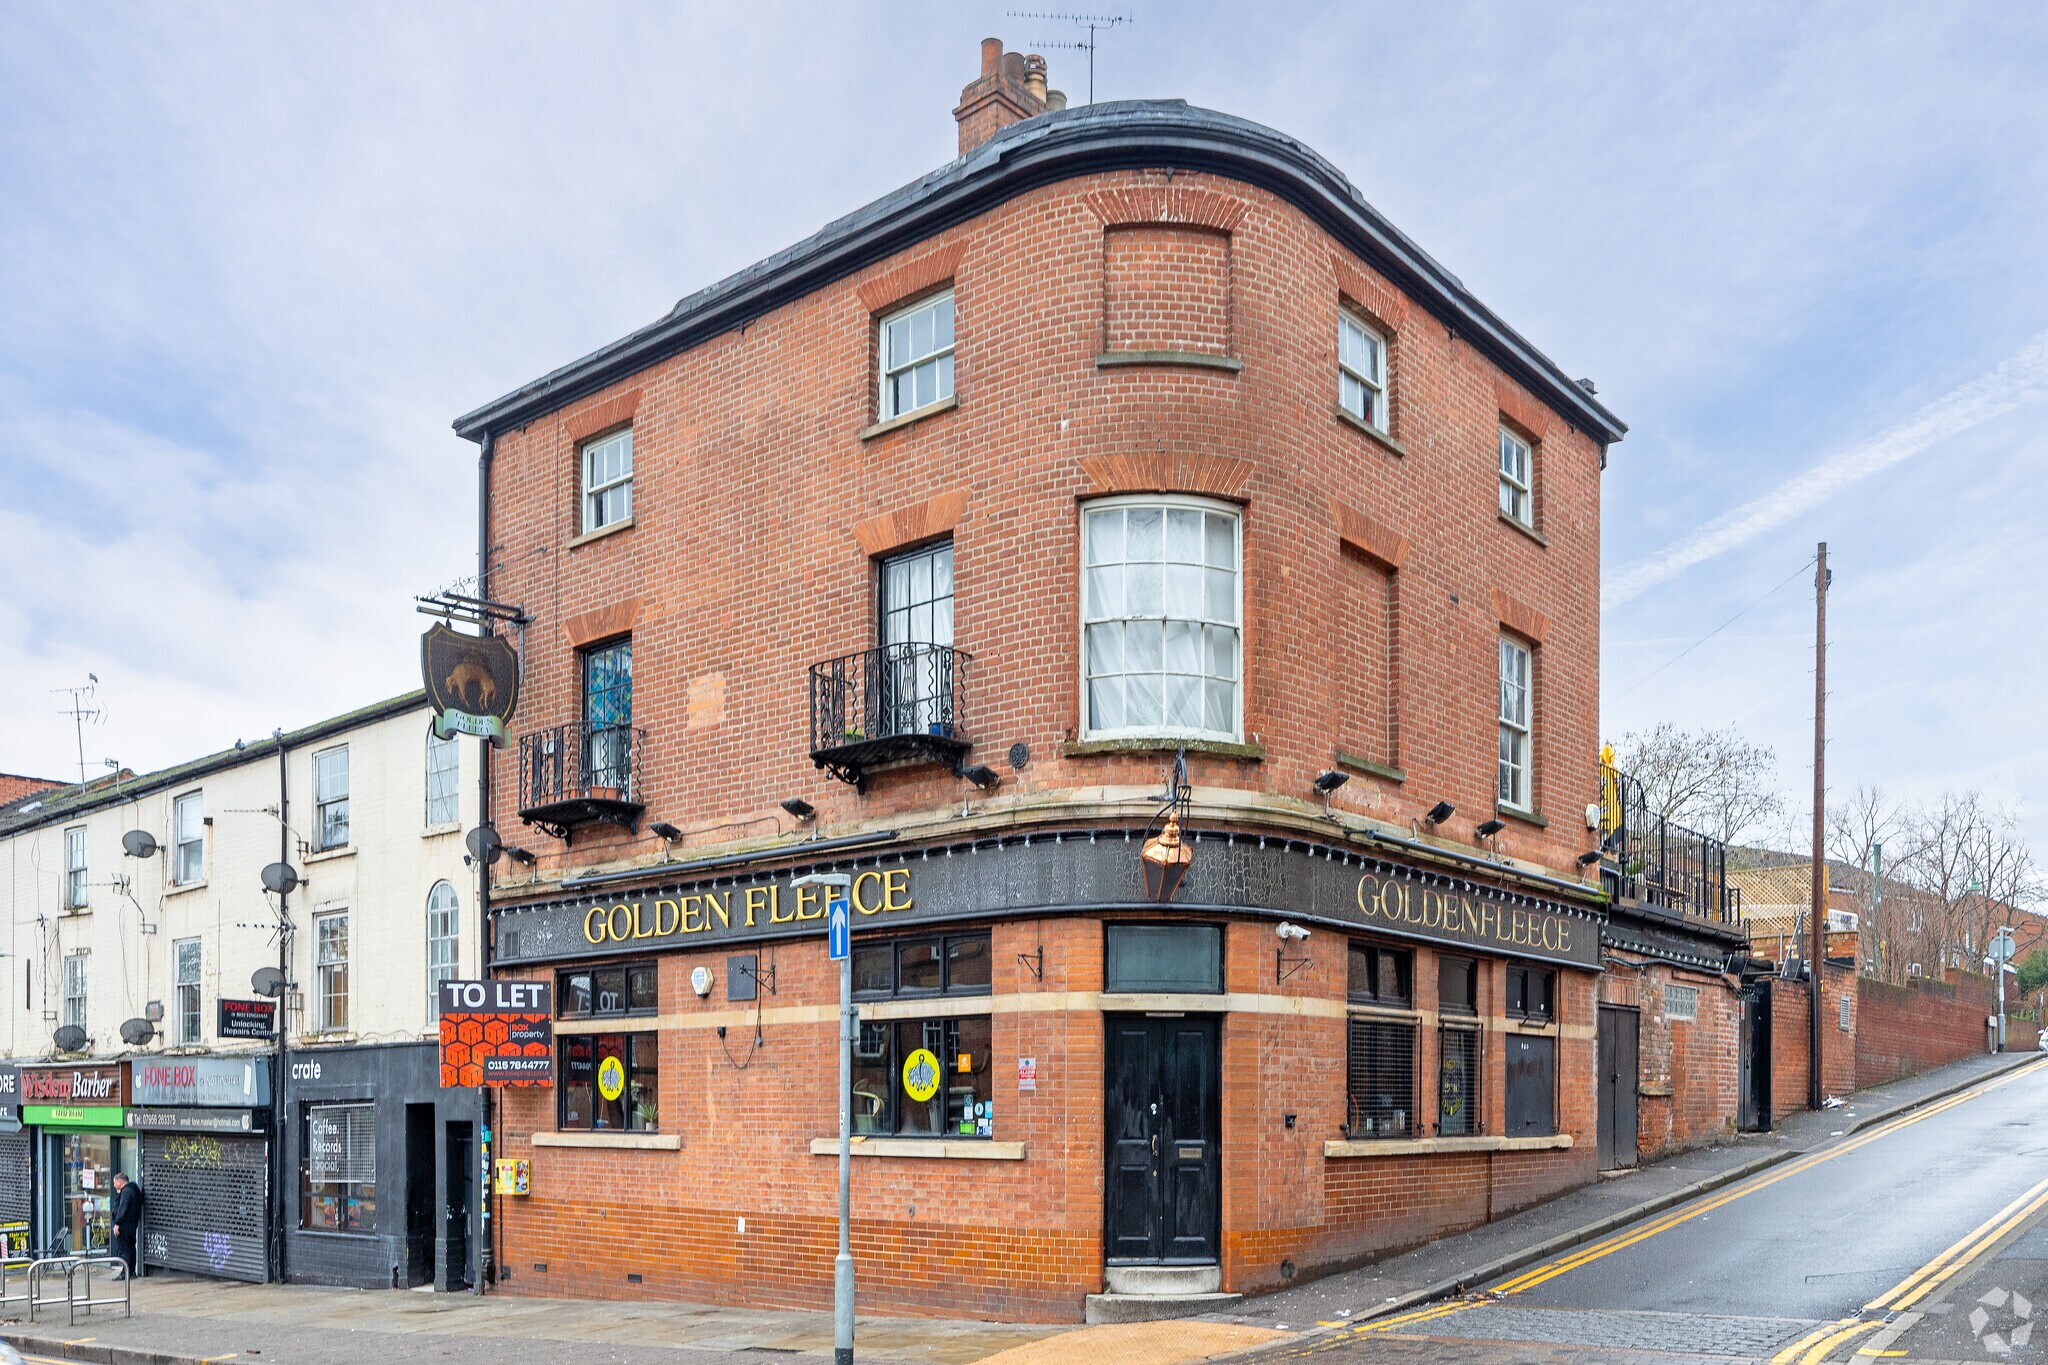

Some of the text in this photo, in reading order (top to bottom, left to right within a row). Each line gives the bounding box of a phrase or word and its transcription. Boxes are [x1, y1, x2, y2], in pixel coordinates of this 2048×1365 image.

[583, 890, 730, 944] GOLDEN
[446, 983, 544, 1008] TO LET
[224, 1001, 274, 1013] FONE BOX
[223, 1027, 250, 1036] Repairs
[511, 1030, 545, 1039] property
[292, 1058, 322, 1080] crate
[487, 1061, 550, 1071] 0115 7844777
[20, 1070, 113, 1099] Wisdom Barber
[143, 1065, 171, 1087] FONE
[173, 1065, 196, 1087] BOX
[312, 1137, 342, 1154] Records
